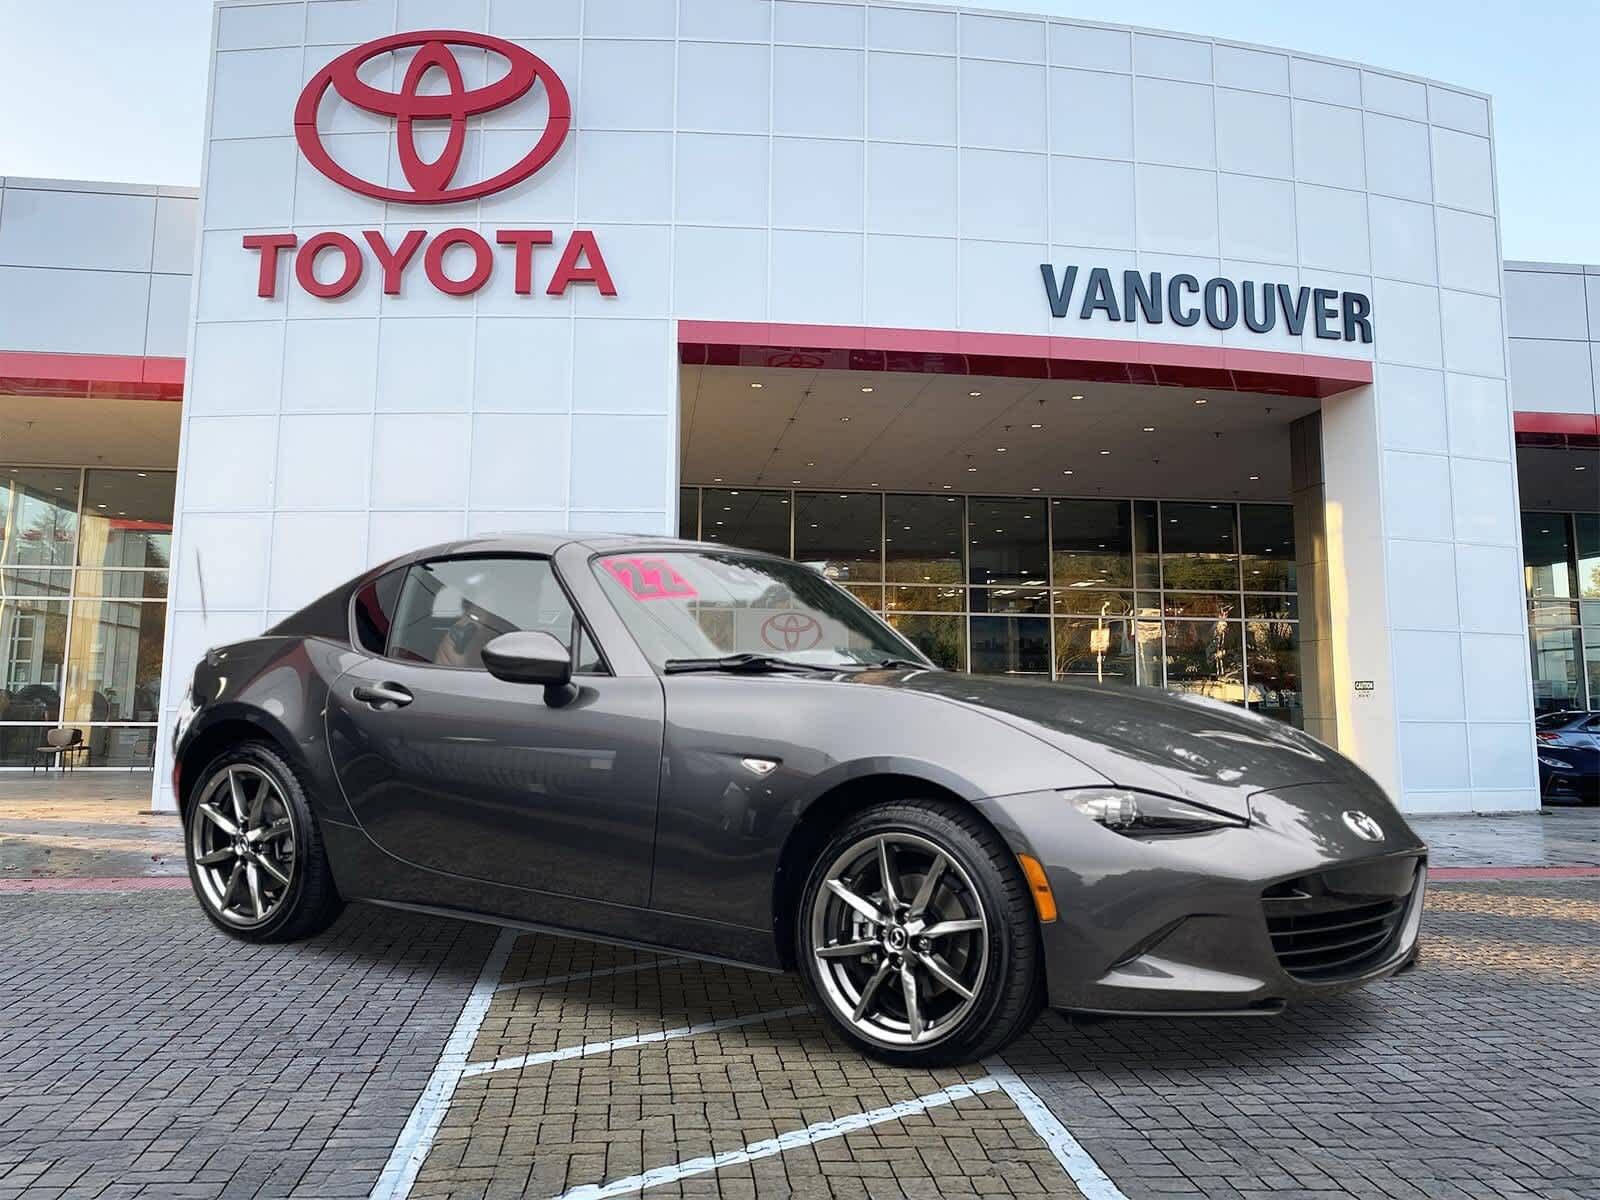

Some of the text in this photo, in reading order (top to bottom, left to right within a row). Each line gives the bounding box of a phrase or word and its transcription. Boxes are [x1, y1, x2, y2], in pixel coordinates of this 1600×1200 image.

[243, 228, 617, 298] TOYOTA
[1040, 264, 1373, 343] VANCOUVER
[613, 561, 689, 595] 22
